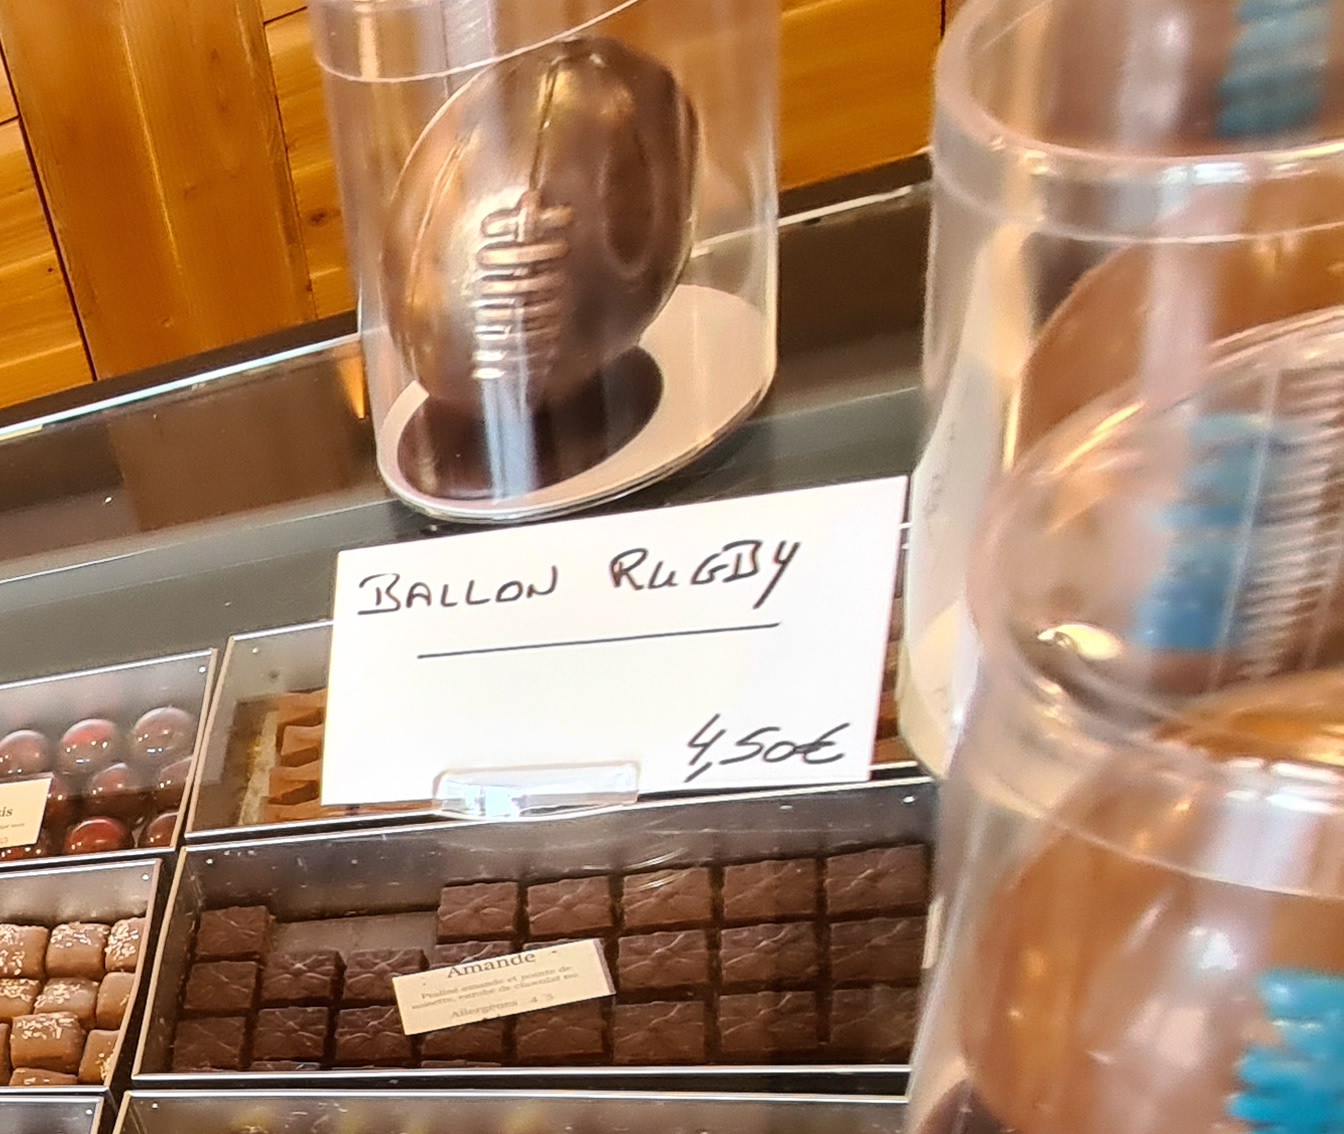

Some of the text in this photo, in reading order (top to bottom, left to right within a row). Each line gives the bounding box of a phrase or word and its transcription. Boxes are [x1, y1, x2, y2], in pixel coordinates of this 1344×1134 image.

[357, 538, 802, 616] BALLON RUGBY
[683, 713, 851, 784] 4,50€
[446, 951, 537, 979] Amande
